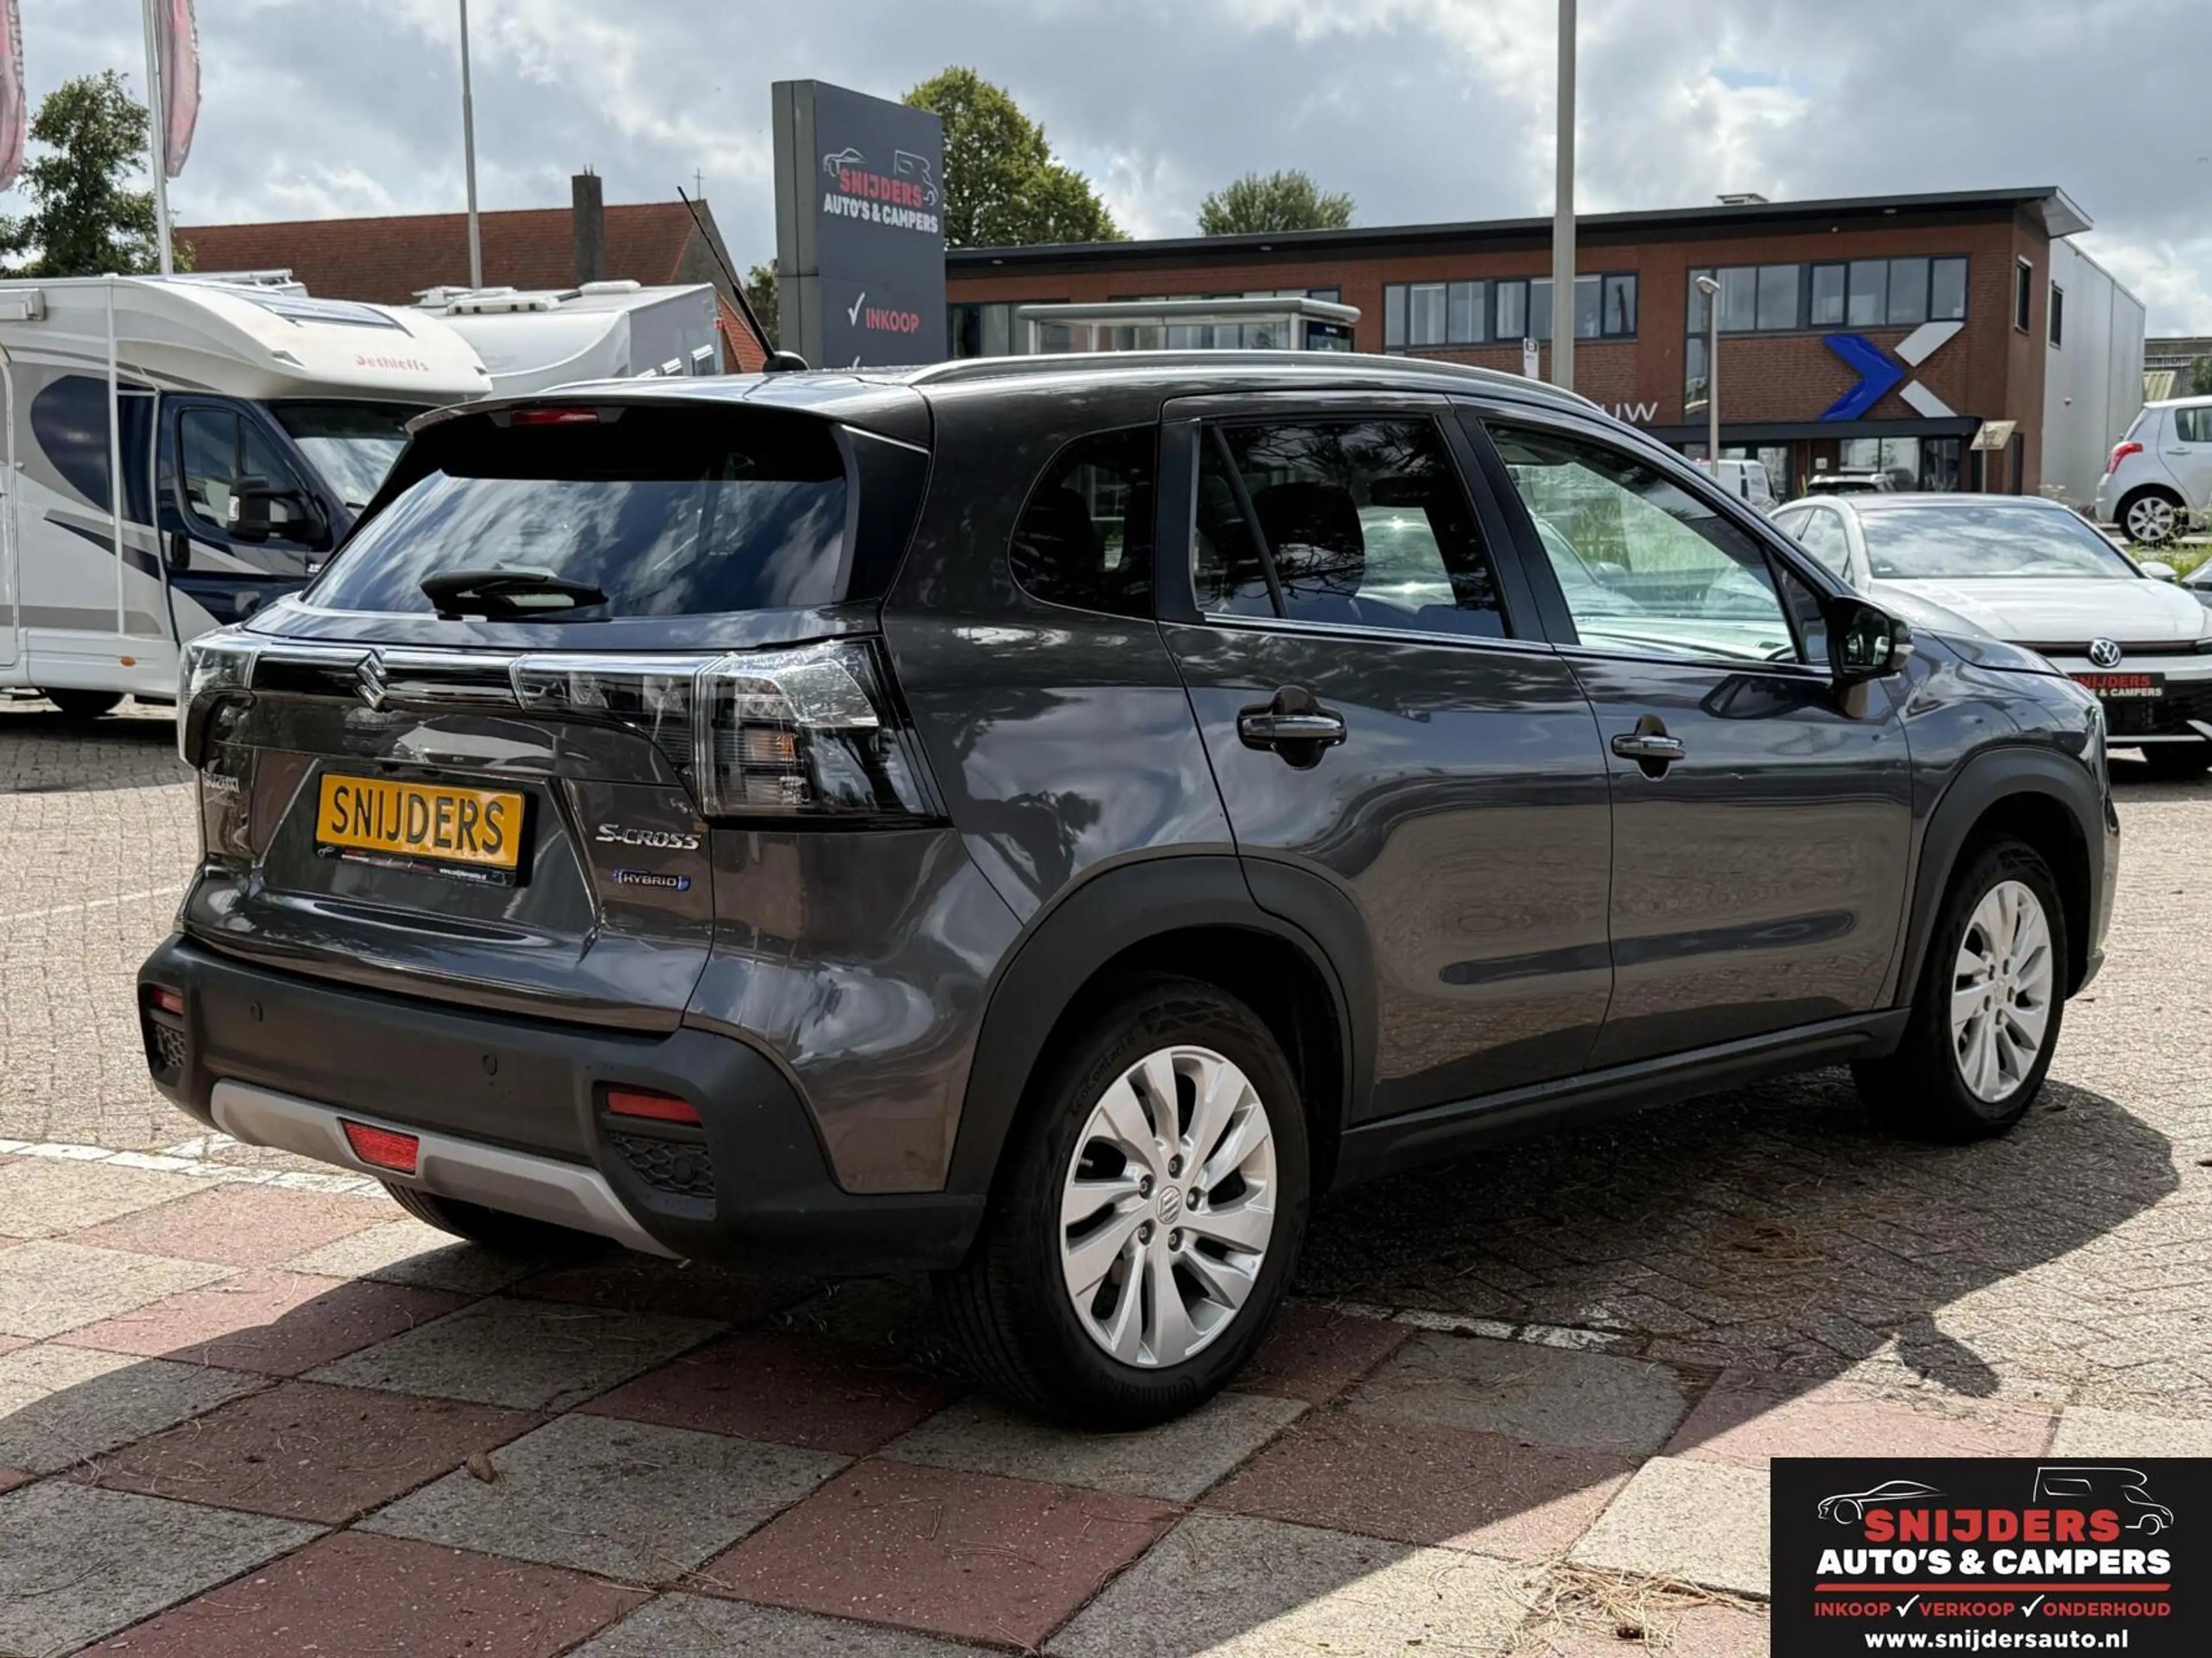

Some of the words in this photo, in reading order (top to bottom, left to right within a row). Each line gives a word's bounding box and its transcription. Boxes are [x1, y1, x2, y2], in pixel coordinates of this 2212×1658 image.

[839, 168, 923, 207] SNIJDERS
[823, 192, 870, 221] AUTO'S
[872, 206, 882, 222] &
[882, 204, 939, 233] CAMPERS
[866, 308, 920, 333] INKOOP
[2111, 688, 2163, 697] CAMPERS
[331, 785, 505, 855] SNIJDERS
[595, 824, 701, 850] S-CROSS
[623, 873, 677, 886] HYBRID
